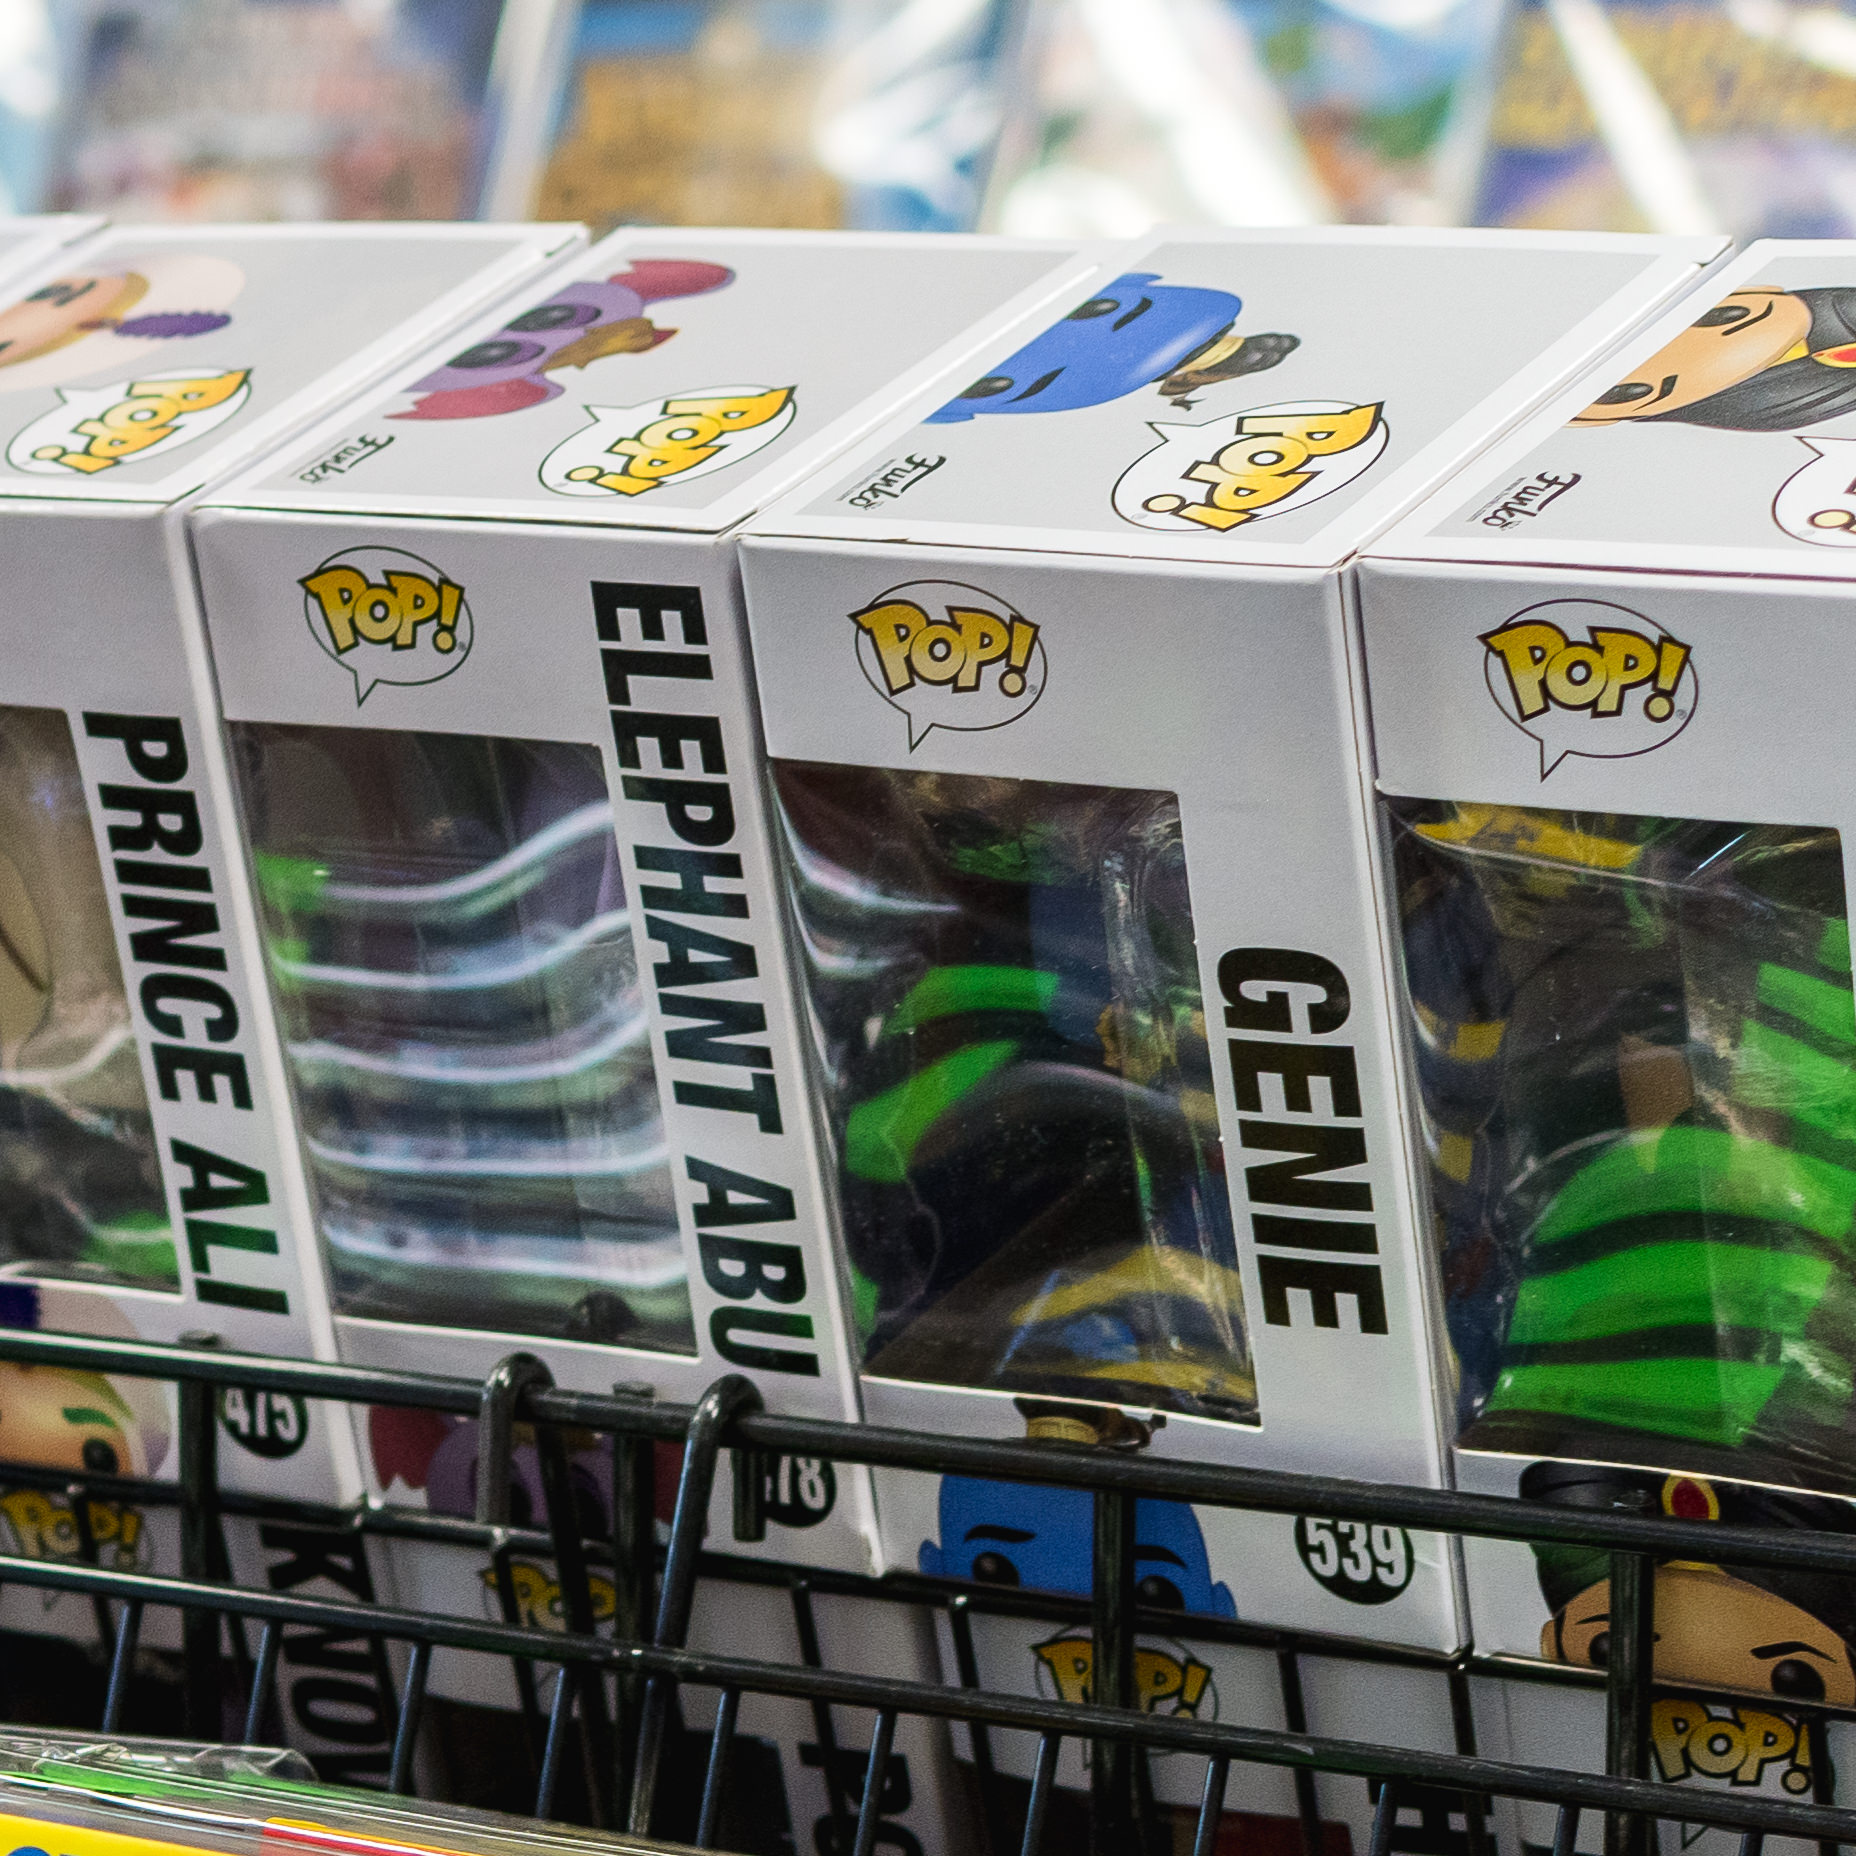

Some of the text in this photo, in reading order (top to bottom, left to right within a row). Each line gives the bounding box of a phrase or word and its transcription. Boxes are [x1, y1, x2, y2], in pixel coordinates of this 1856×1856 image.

[31, 369, 253, 474] POP!
[299, 433, 395, 483] Funko
[566, 385, 798, 497] POP!
[1142, 402, 1385, 532] POP!
[849, 452, 947, 507] Funko
[1482, 470, 1582, 528] Funko
[298, 565, 465, 657] POP!
[848, 602, 1040, 698] POP!
[1476, 620, 1692, 722] POP!
[81, 710, 290, 1316] PRINCE ALI
[590, 580, 821, 1378] ELEPHANT ABU
[1215, 946, 1389, 1337] GENIE
[1308, 1514, 1411, 1582] 539
